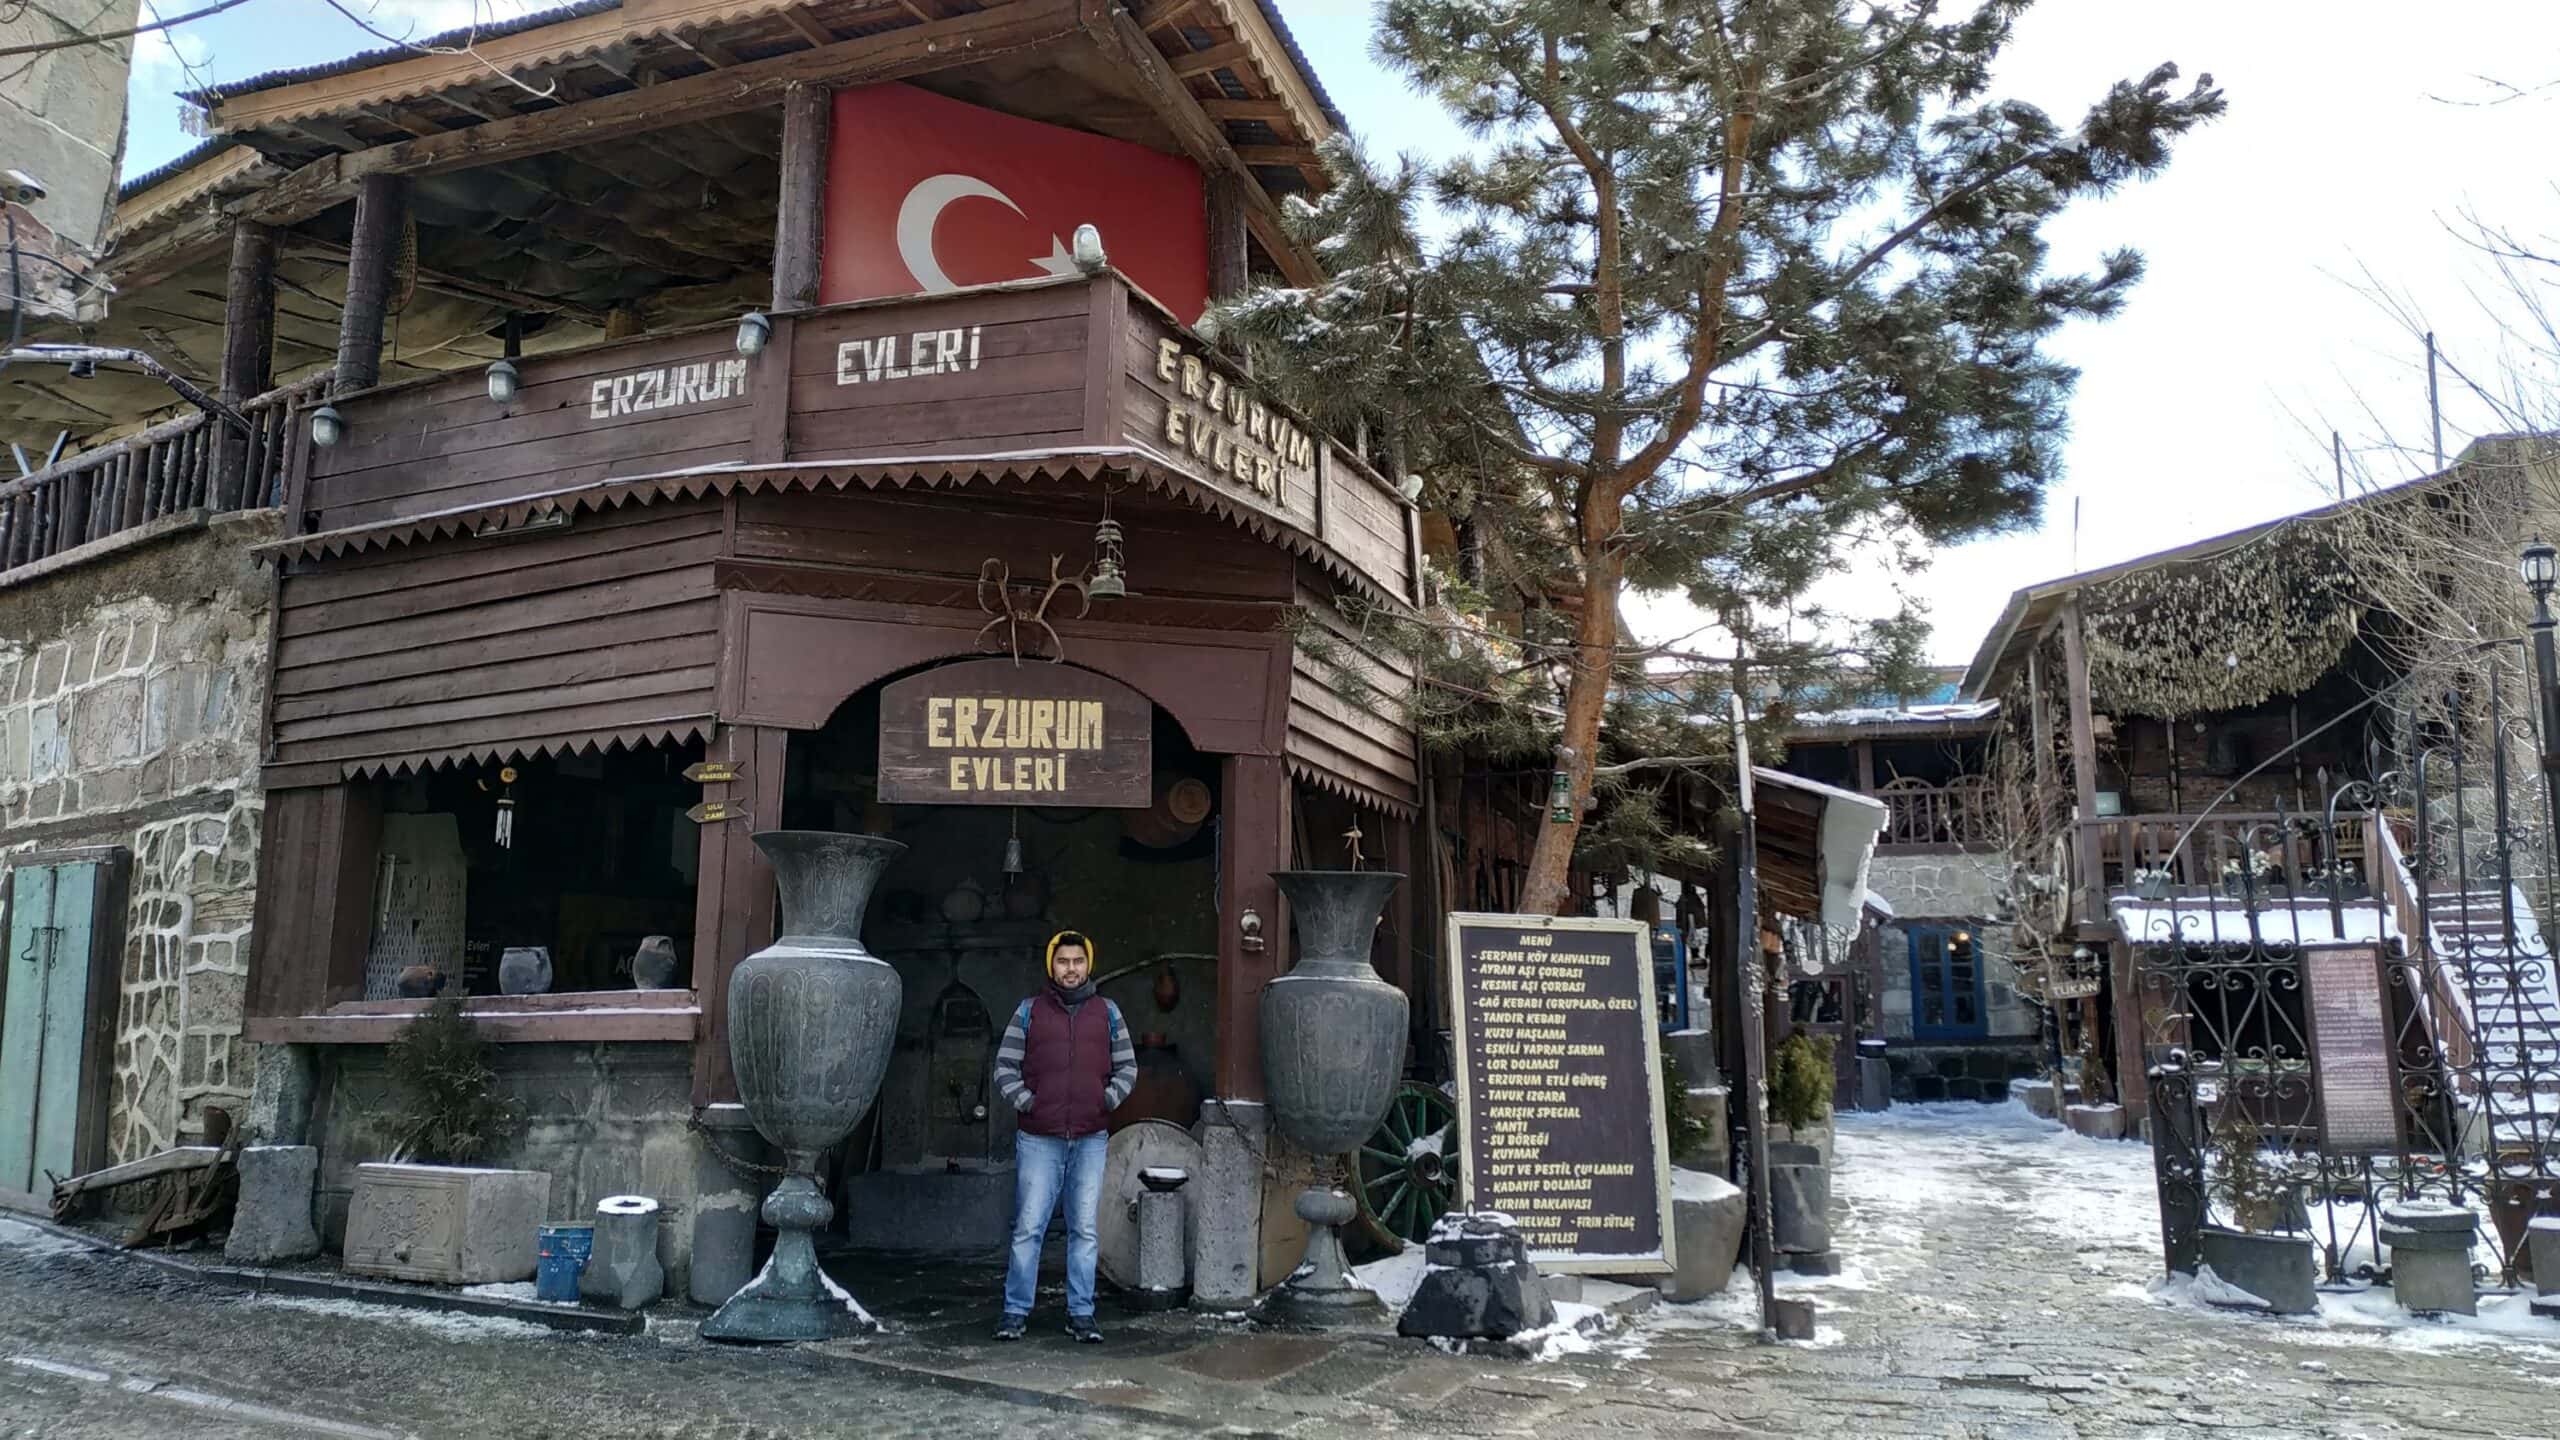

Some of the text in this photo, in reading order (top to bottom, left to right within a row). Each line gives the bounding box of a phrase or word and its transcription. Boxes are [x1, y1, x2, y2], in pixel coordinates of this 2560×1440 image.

[590, 326, 981, 420] ERZURUM EVLERİ
[1157, 337, 1313, 472] ERZURUM
[928, 697, 1104, 751] ERZURUM
[950, 752, 1066, 793] EVLERİ
[1519, 934, 1553, 947] MENÜ
[1479, 950, 1611, 966] SERPME KÖY KAHVALTISI
[1480, 963, 1584, 979] AYRAN AŞI ÇORBASI
[1481, 980, 1586, 994] KESME AŞI ÇORBASI
[1503, 998, 1543, 1009] KEBABI
[1483, 1011, 1566, 1024] TANDIR KEBABI
[1484, 1028, 1567, 1042] KUZU HAŞLAMA
[1523, 1044, 1566, 1056] YAPRAK
[1567, 1044, 1605, 1056] SARMA
[1487, 1059, 1560, 1071] LOR DOLMASI
[1488, 1074, 1542, 1086] ERZURUM
[1571, 1072, 1608, 1090] GÜVEÇ
[1488, 1090, 1566, 1102] TAVUK IZGARA
[1489, 1106, 1581, 1120] KARIŞIK SPECIAL
[1490, 1134, 1505, 1146] SU
[1492, 1147, 1540, 1160] KUYMAK
[1492, 1163, 1515, 1175] DUT
[1517, 1164, 1532, 1175] VE
[1493, 1179, 1592, 1194] KADAYIF DOLMASI
[1494, 1198, 1592, 1210] KIRIM BAKLAVASI
[1577, 1216, 1602, 1228] FIRIN
[1537, 1232, 1579, 1244] TATLISI
